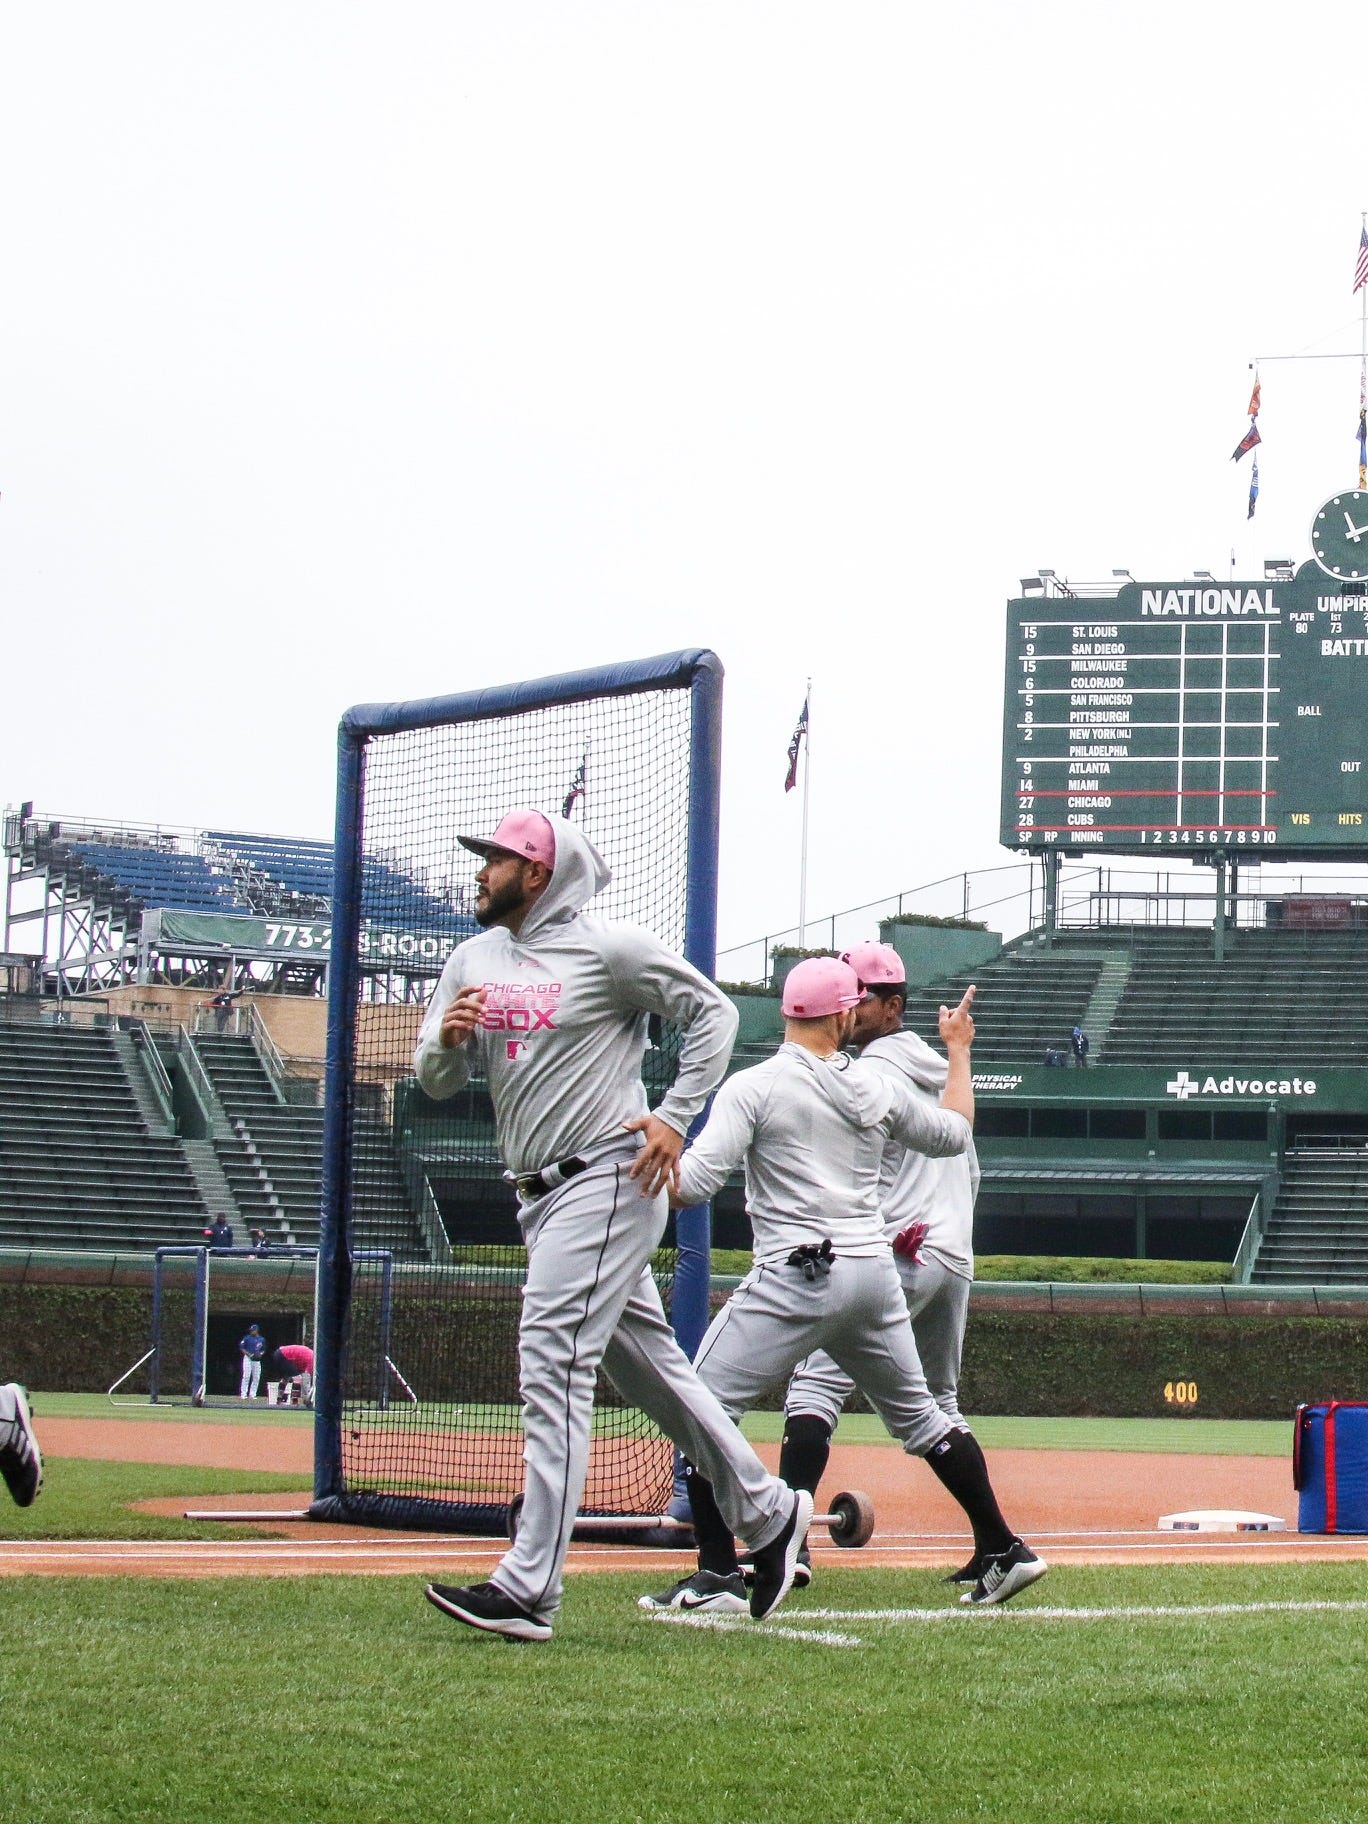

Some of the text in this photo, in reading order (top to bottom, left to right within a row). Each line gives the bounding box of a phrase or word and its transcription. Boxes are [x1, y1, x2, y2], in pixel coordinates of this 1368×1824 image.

[1141, 588, 1281, 616] NATIONAL
[1289, 612, 1315, 622] PLATE
[1024, 625, 1118, 639] 15 ST. LOUIS
[1295, 622, 1308, 634] 80
[1329, 621, 1343, 634] 73
[1026, 642, 1126, 656] 9 SAN DIEGO
[1023, 659, 1128, 673] 15 MILWAUKEE
[1025, 676, 1125, 690] 6 COLORADO
[1024, 693, 1133, 707] 5 SAN FRANCISCO
[1024, 710, 1130, 724] 8 PITTSBURGH
[1297, 705, 1322, 716] BALL
[1023, 728, 1033, 741] 2
[1069, 728, 1091, 740] NEW
[1069, 745, 1129, 757] PHILADELPHIA
[1023, 762, 1111, 775] 9 ATLANTA
[1340, 761, 1362, 773] OUT
[1020, 778, 1099, 792] 14 MIAMI
[1018, 795, 1112, 809] 27 CHICAGO
[1018, 813, 1095, 827] 28 CUBS
[1291, 813, 1311, 825] VIS
[1338, 813, 1363, 826] HITS
[1018, 830, 1033, 843] SP
[1044, 830, 1059, 843] RP
[1070, 830, 1104, 843] INNING
[1153, 830, 1163, 844] 2
[1168, 830, 1178, 844] 3
[1180, 830, 1191, 844] 4
[1195, 830, 1205, 844] 5
[1209, 830, 1218, 844] 6
[1224, 830, 1233, 844] 7
[1236, 830, 1247, 844] 8
[1250, 830, 1261, 844] 9
[1263, 830, 1277, 844] 10
[483, 983, 562, 993] CHICAGO
[482, 1009, 558, 1030] SOX
[971, 1074, 1023, 1083] PHYSICAL
[1201, 1076, 1317, 1095] Advocate
[970, 1082, 1018, 1090] THERAPY
[1163, 1381, 1199, 1403] 400
